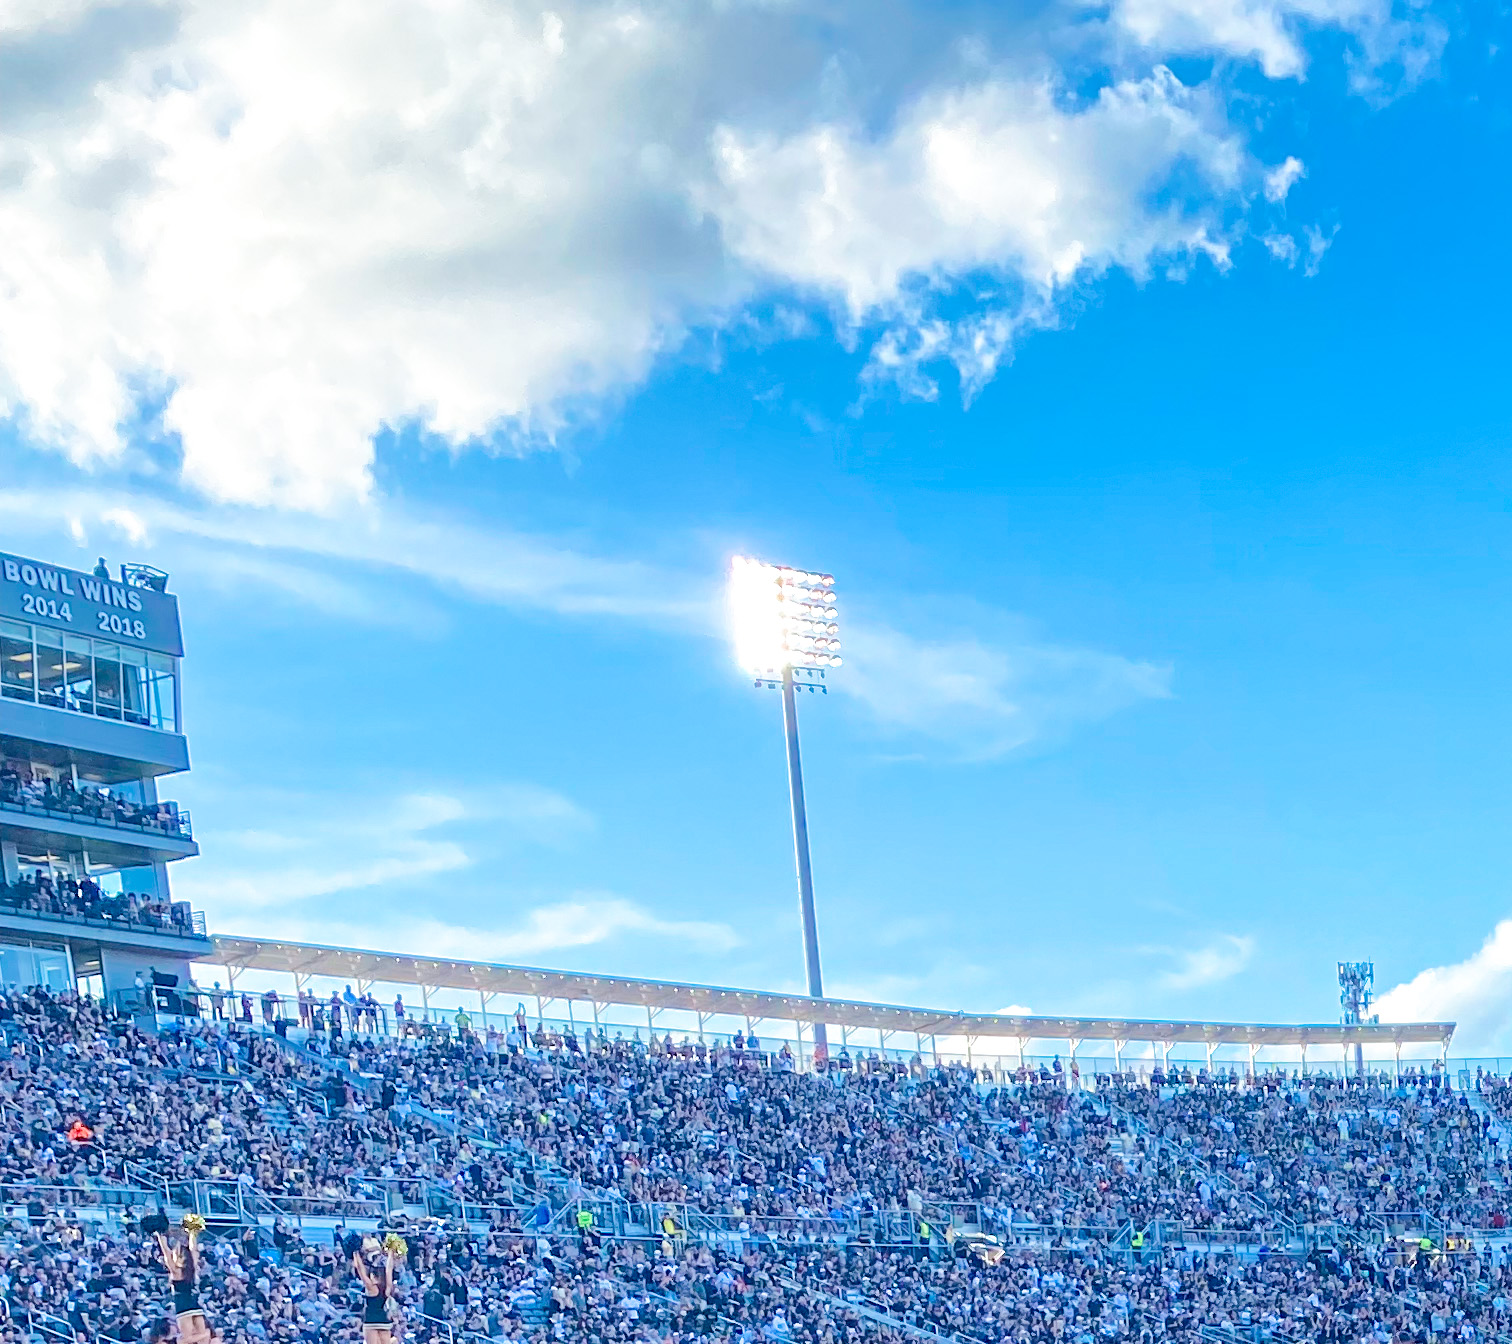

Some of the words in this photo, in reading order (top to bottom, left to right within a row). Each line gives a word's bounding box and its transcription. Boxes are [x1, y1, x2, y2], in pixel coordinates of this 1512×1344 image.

[2, 559, 75, 596] BOWL
[80, 577, 143, 612] WINS
[22, 593, 72, 622] 2014
[97, 611, 146, 640] 2018
